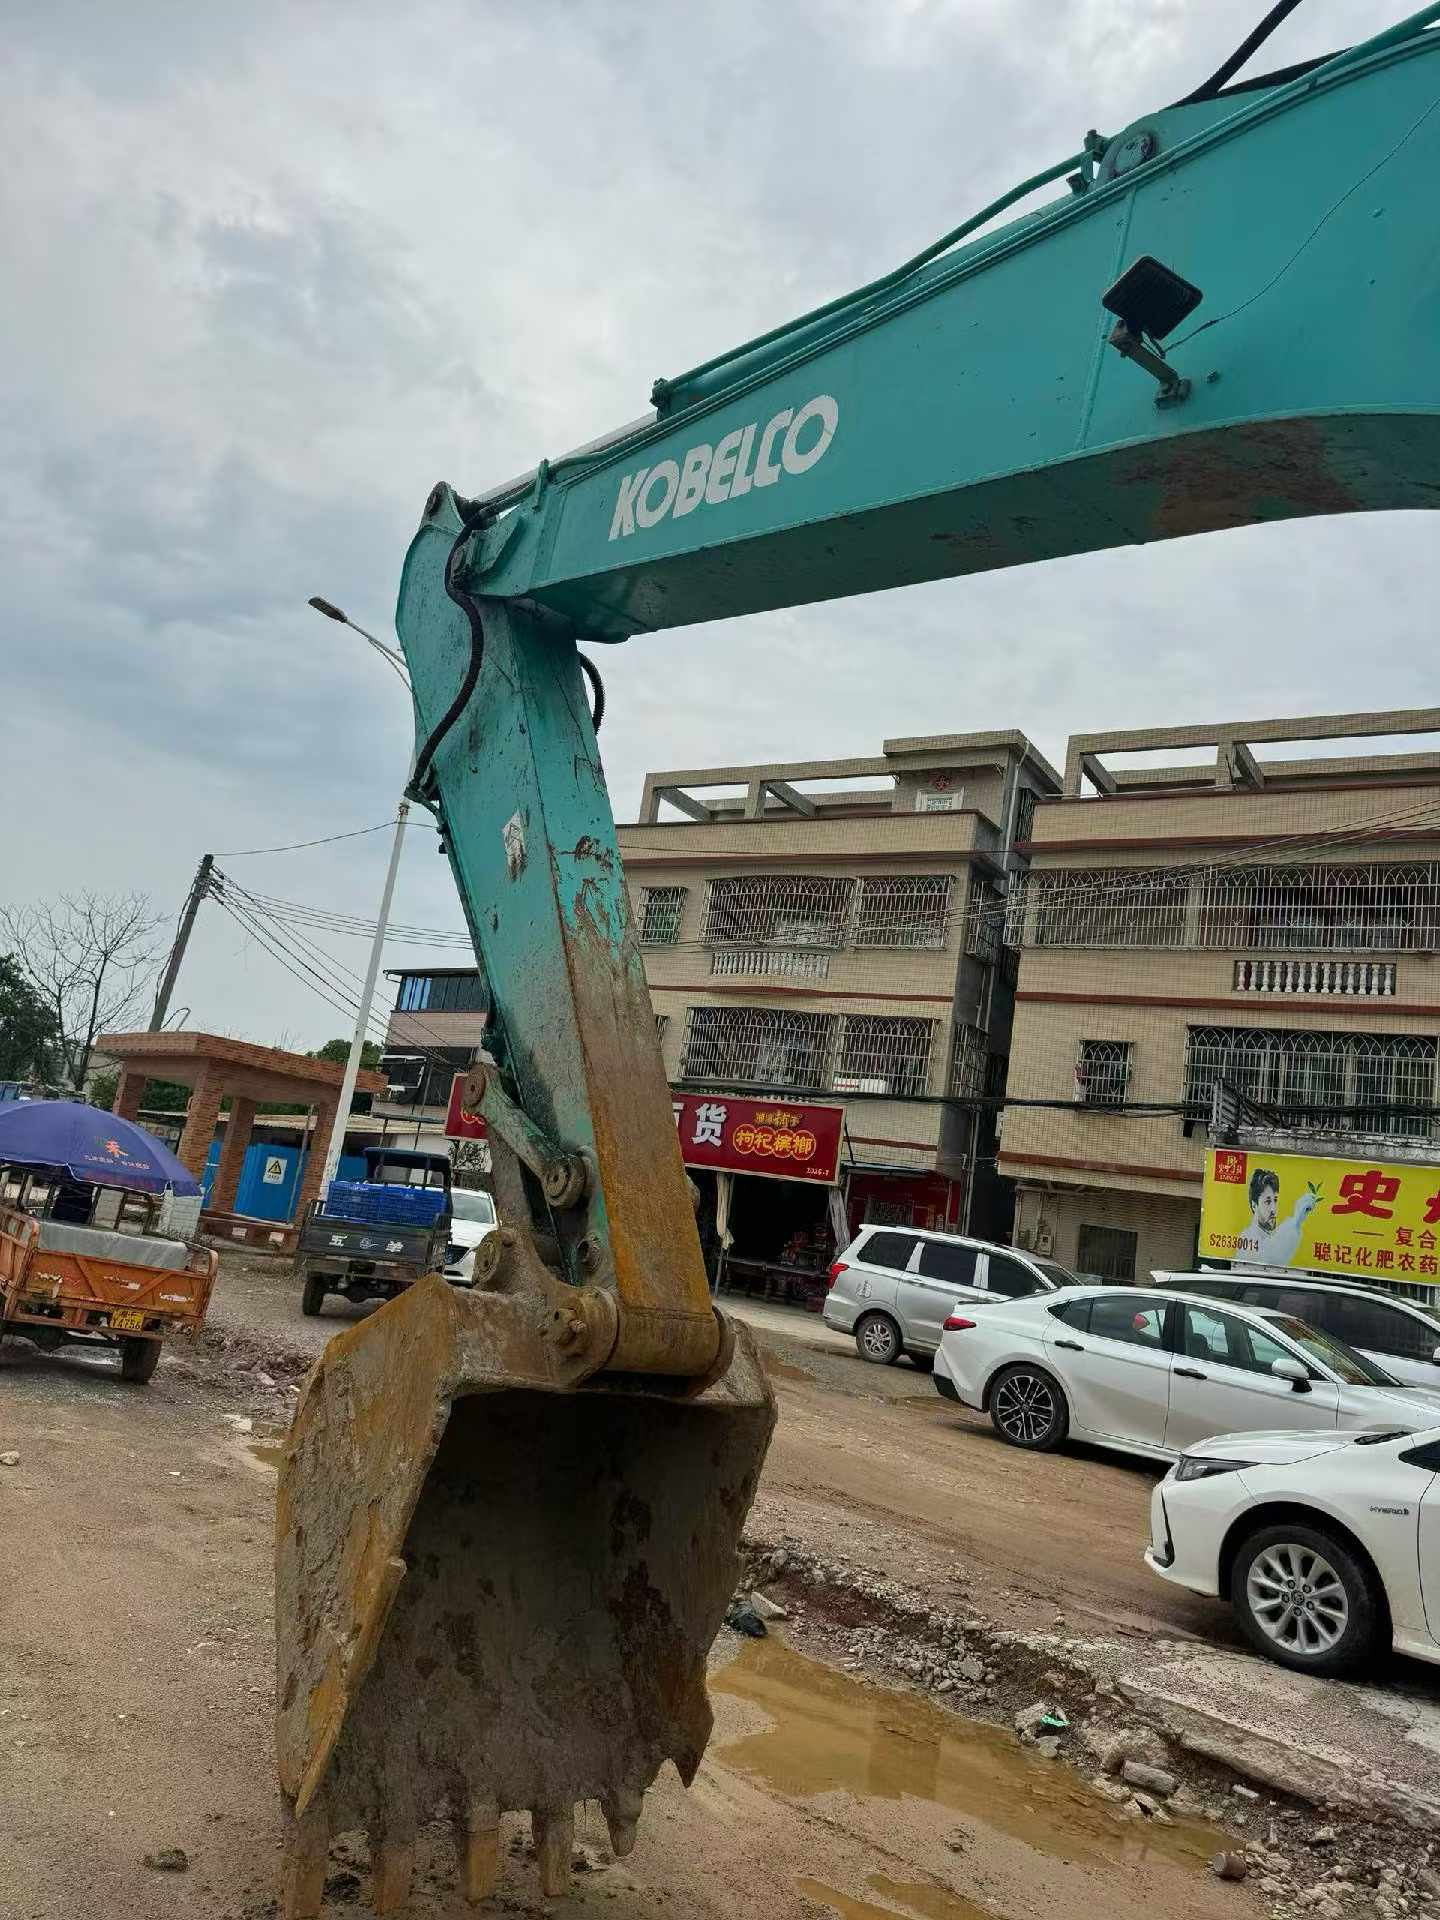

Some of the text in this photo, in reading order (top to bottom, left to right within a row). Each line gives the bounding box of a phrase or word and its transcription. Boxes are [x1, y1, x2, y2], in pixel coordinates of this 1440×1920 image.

[608, 394, 839, 541] KOBELCO
[1209, 1232, 1260, 1251] S26330014
[1313, 1242, 1438, 1275] 聪记化肥农药
